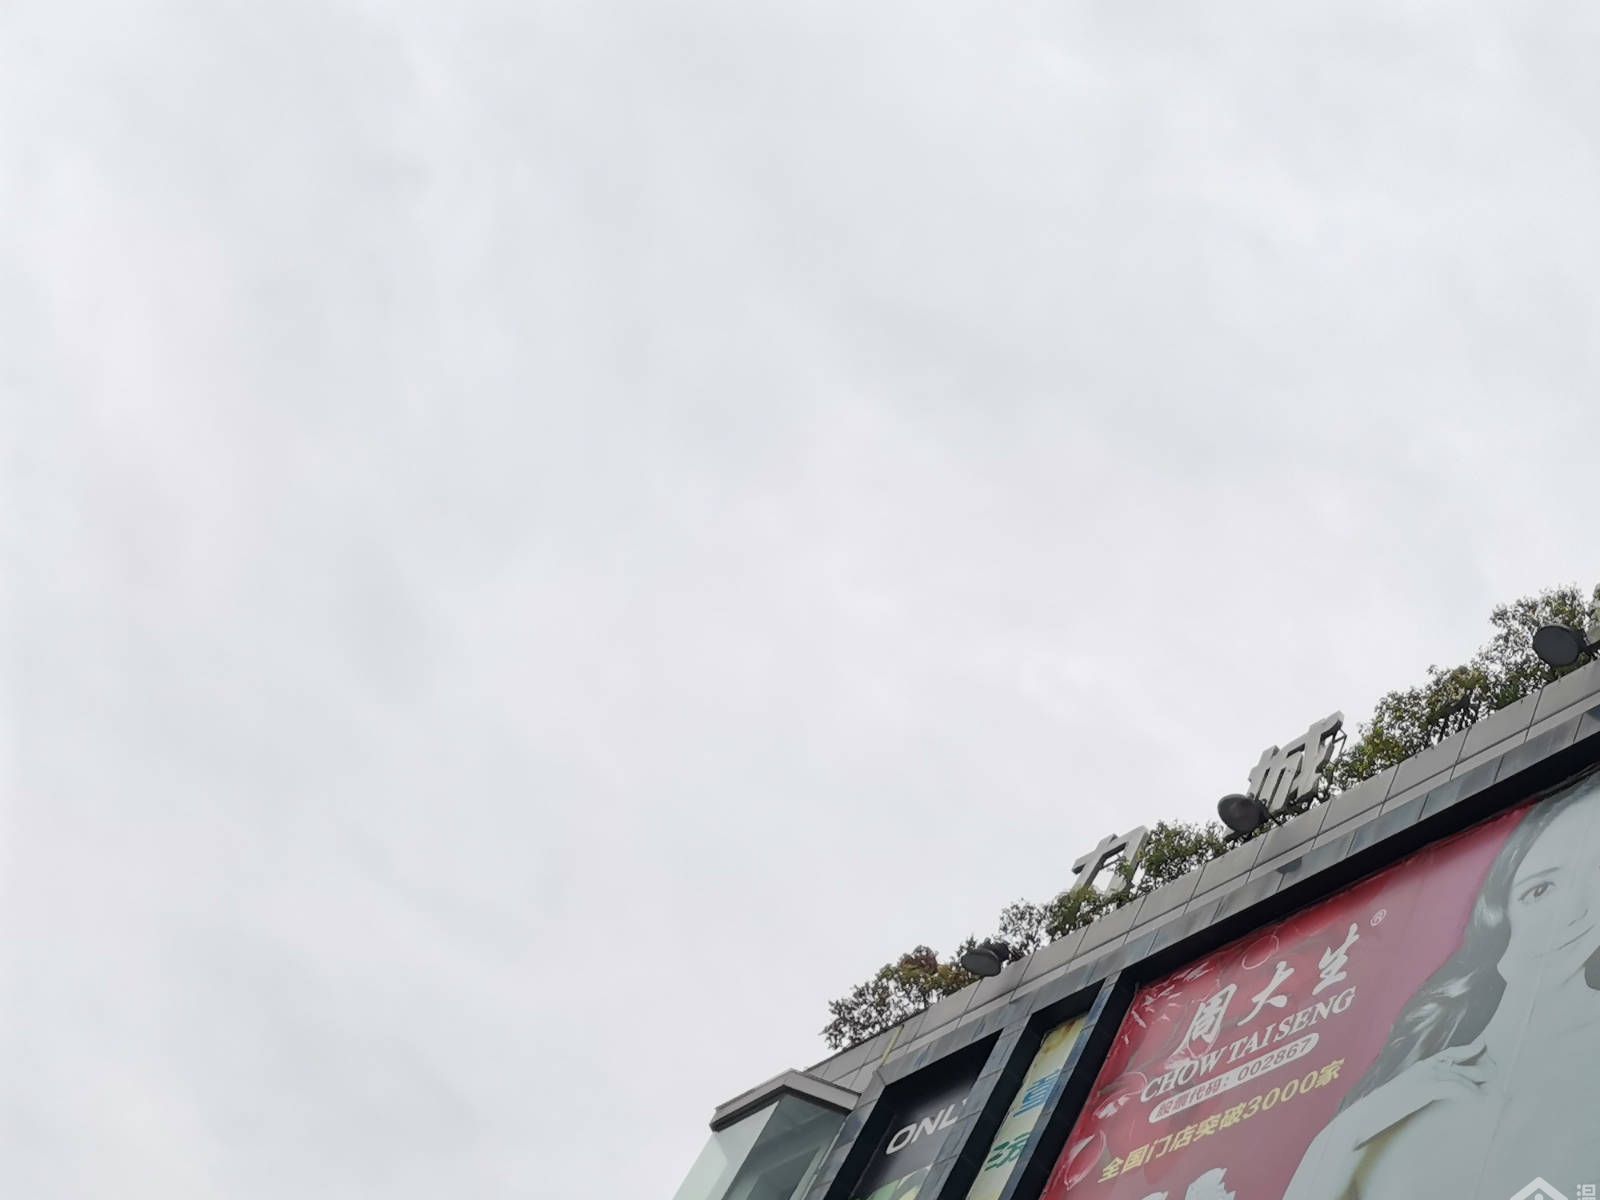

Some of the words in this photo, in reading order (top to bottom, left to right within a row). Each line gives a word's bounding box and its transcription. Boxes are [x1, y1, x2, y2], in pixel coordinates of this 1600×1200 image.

[1176, 923, 1359, 1052] 周大生
[1098, 1058, 1345, 1183] 全国门店突破3000家
[1141, 1049, 1224, 1103] CHOW
